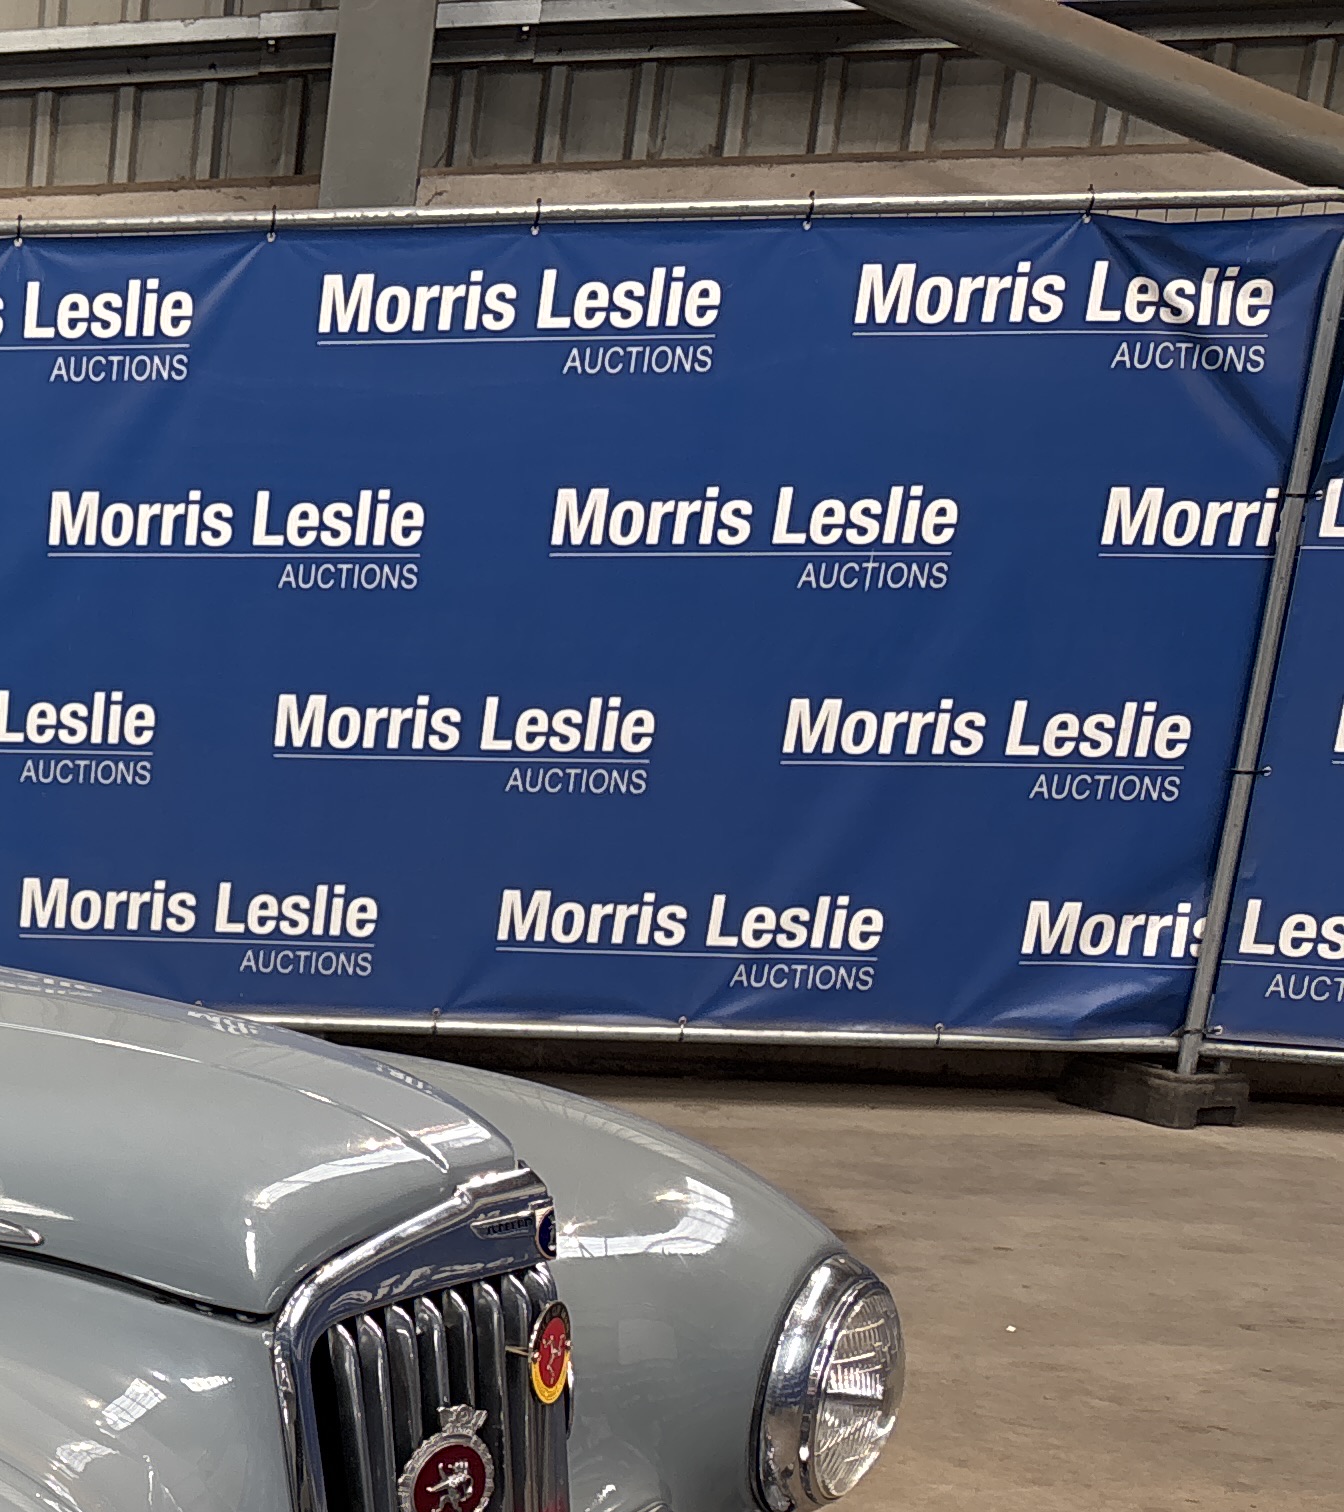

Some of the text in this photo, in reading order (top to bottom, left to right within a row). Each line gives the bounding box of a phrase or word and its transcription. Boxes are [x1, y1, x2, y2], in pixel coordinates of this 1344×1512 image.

[24, 279, 192, 338] Leslie
[319, 266, 720, 332] Morris Leslie
[855, 261, 1273, 326] Morris Leslie
[50, 355, 188, 381] AUCTIONS
[563, 346, 712, 374] AUCTIONS
[1111, 342, 1265, 372] AUCTIONS
[49, 489, 424, 546] Morris Leslie
[551, 486, 957, 545] Morris Leslie
[1101, 487, 1279, 546] Morri
[278, 564, 417, 589] AUCTIONS
[797, 561, 950, 590] AUCTIONS
[275, 694, 654, 752] Morris Leslie
[783, 698, 1191, 758] Morris Leslie
[20, 760, 150, 784] AUCTIONS
[506, 768, 647, 794] AUCTIONS
[1030, 774, 1180, 801] AUCTIONS
[20, 878, 377, 937] Morris Leslie
[497, 890, 883, 952] Morris Leslie
[1239, 899, 1344, 959] Les
[240, 950, 371, 976] AUCTIONS
[730, 964, 874, 990] AUCTIONS
[1265, 974, 1344, 1001] AUCT
